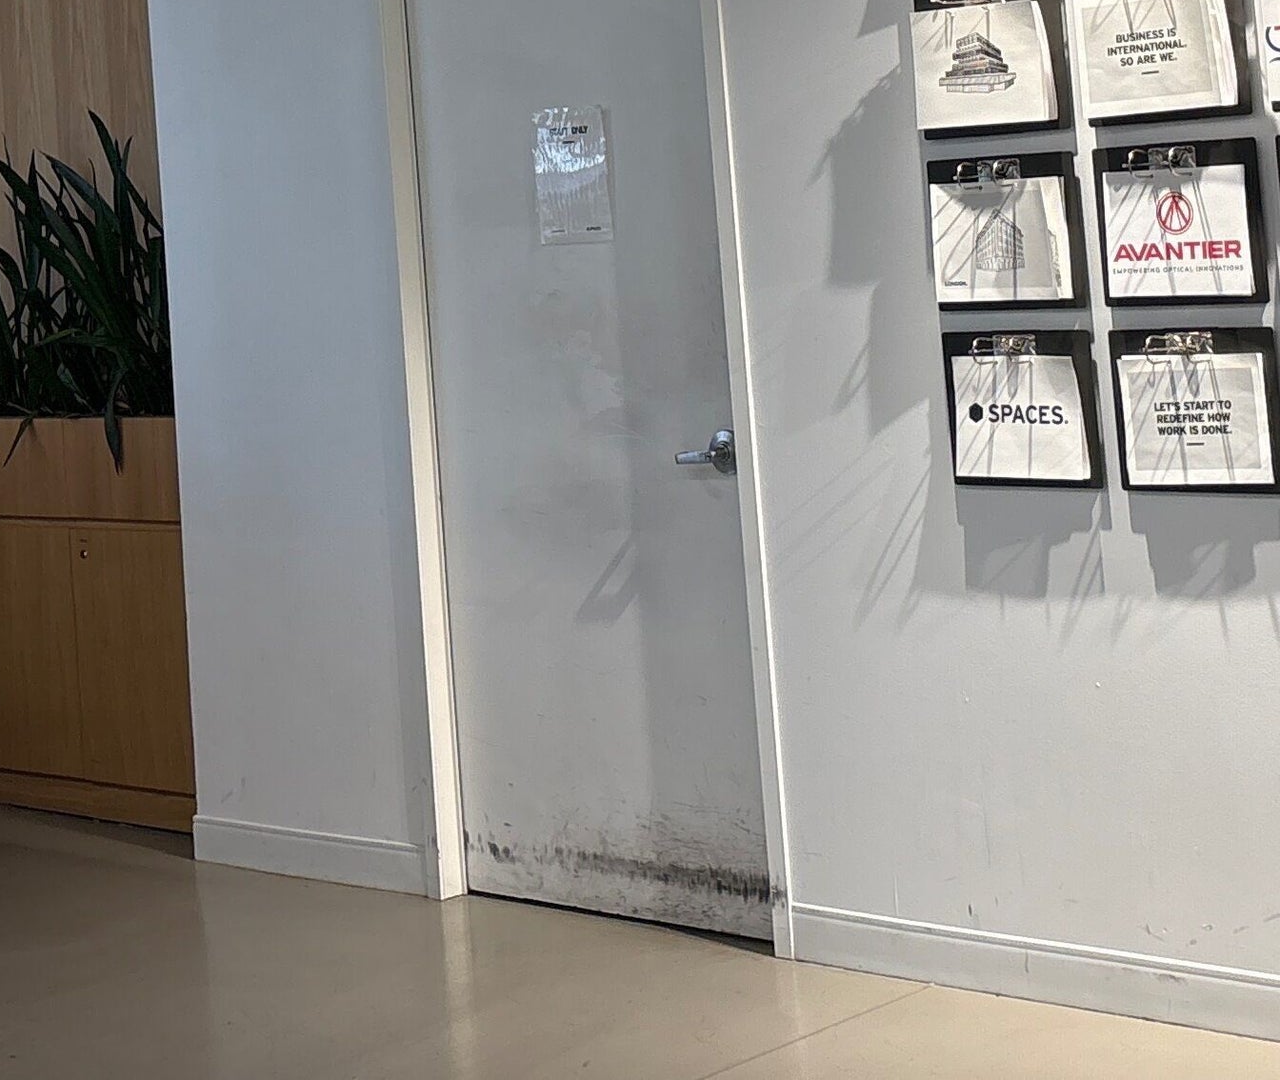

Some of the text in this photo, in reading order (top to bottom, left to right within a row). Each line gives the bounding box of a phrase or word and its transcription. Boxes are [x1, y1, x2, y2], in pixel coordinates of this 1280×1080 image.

[1115, 27, 1177, 43] BUSINESS IS
[1107, 39, 1187, 57] INTERNATIONAL.
[1120, 52, 1178, 67] SO ARE WE.
[1113, 239, 1242, 262] AVANTIER
[1112, 267, 1161, 275] EMPOWERING
[1195, 264, 1244, 272] INNOVATIONS
[1154, 400, 1232, 412] LET'S START TO
[1156, 412, 1231, 424] REDEFINE HOW
[1157, 424, 1233, 436] WORK IS DONE.
